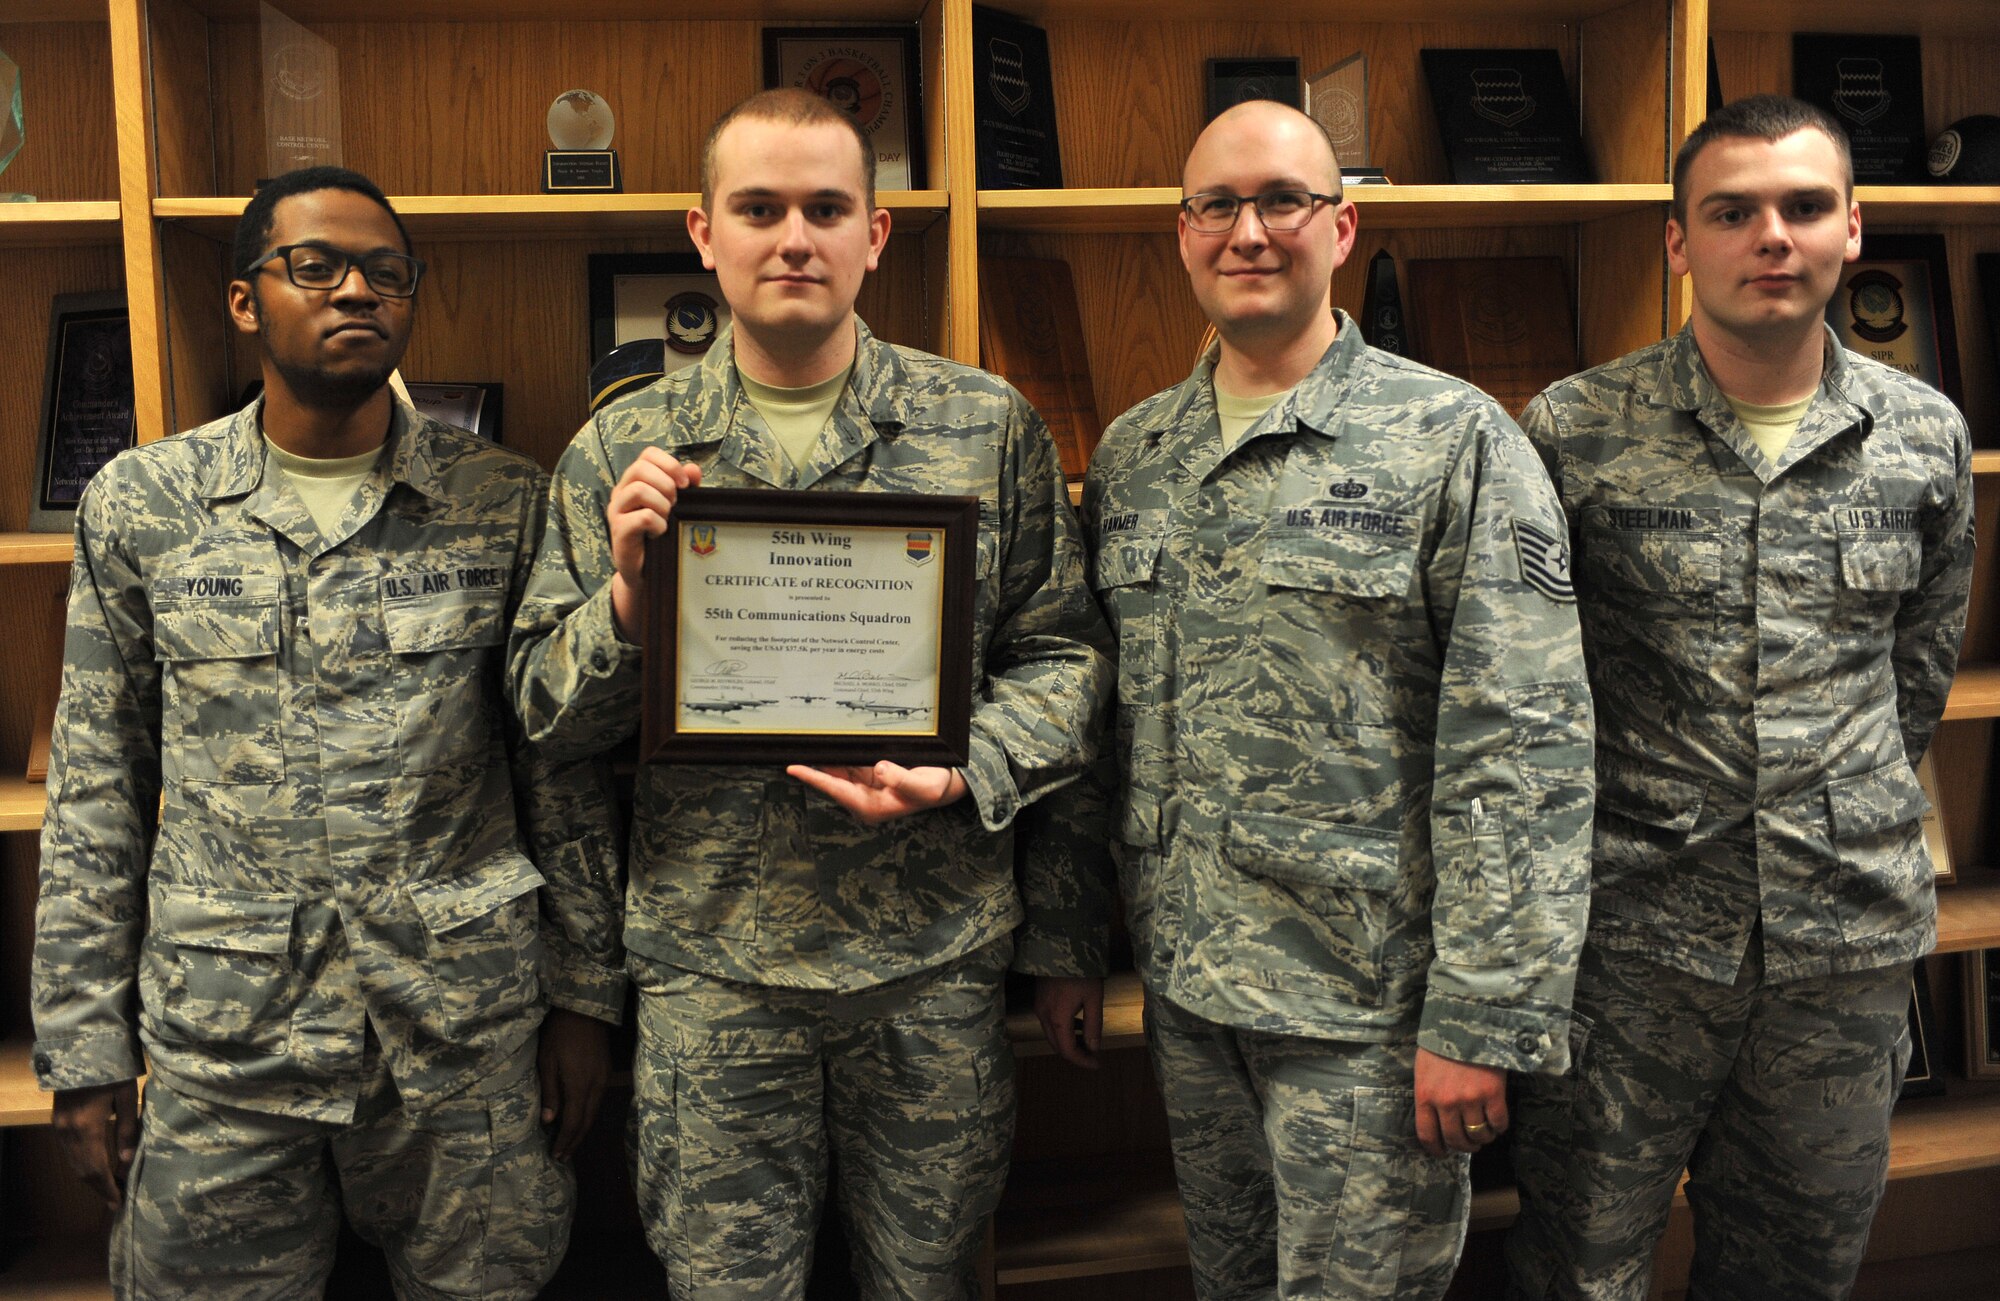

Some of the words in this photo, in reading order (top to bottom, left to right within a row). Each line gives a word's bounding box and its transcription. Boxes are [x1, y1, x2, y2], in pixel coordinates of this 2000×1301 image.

[828, 47, 891, 88] BASKETBALL
[879, 153, 900, 162] DAY
[1871, 351, 1895, 361] SIPR
[1286, 508, 1315, 527] U.S.
[1320, 508, 1347, 528] AIR
[1351, 510, 1403, 537] FORCE
[1609, 508, 1692, 529] STEELMAN
[1848, 509, 1878, 529] U.S.
[771, 530, 805, 545] 55th
[811, 531, 852, 550] Wing
[769, 551, 852, 568] Innovation
[186, 577, 243, 597] YOUNG
[386, 578, 416, 598] U.S.
[422, 573, 451, 594] AIR
[456, 567, 500, 588] FORCE
[705, 574, 797, 588] CERTIFICATE
[801, 577, 812, 588] of
[816, 578, 913, 591] RECOGNITION
[704, 607, 733, 619] 55th
[737, 608, 845, 622] Communications
[849, 611, 911, 625] Squadron
[728, 635, 757, 643] reducing
[770, 636, 799, 644] footprint
